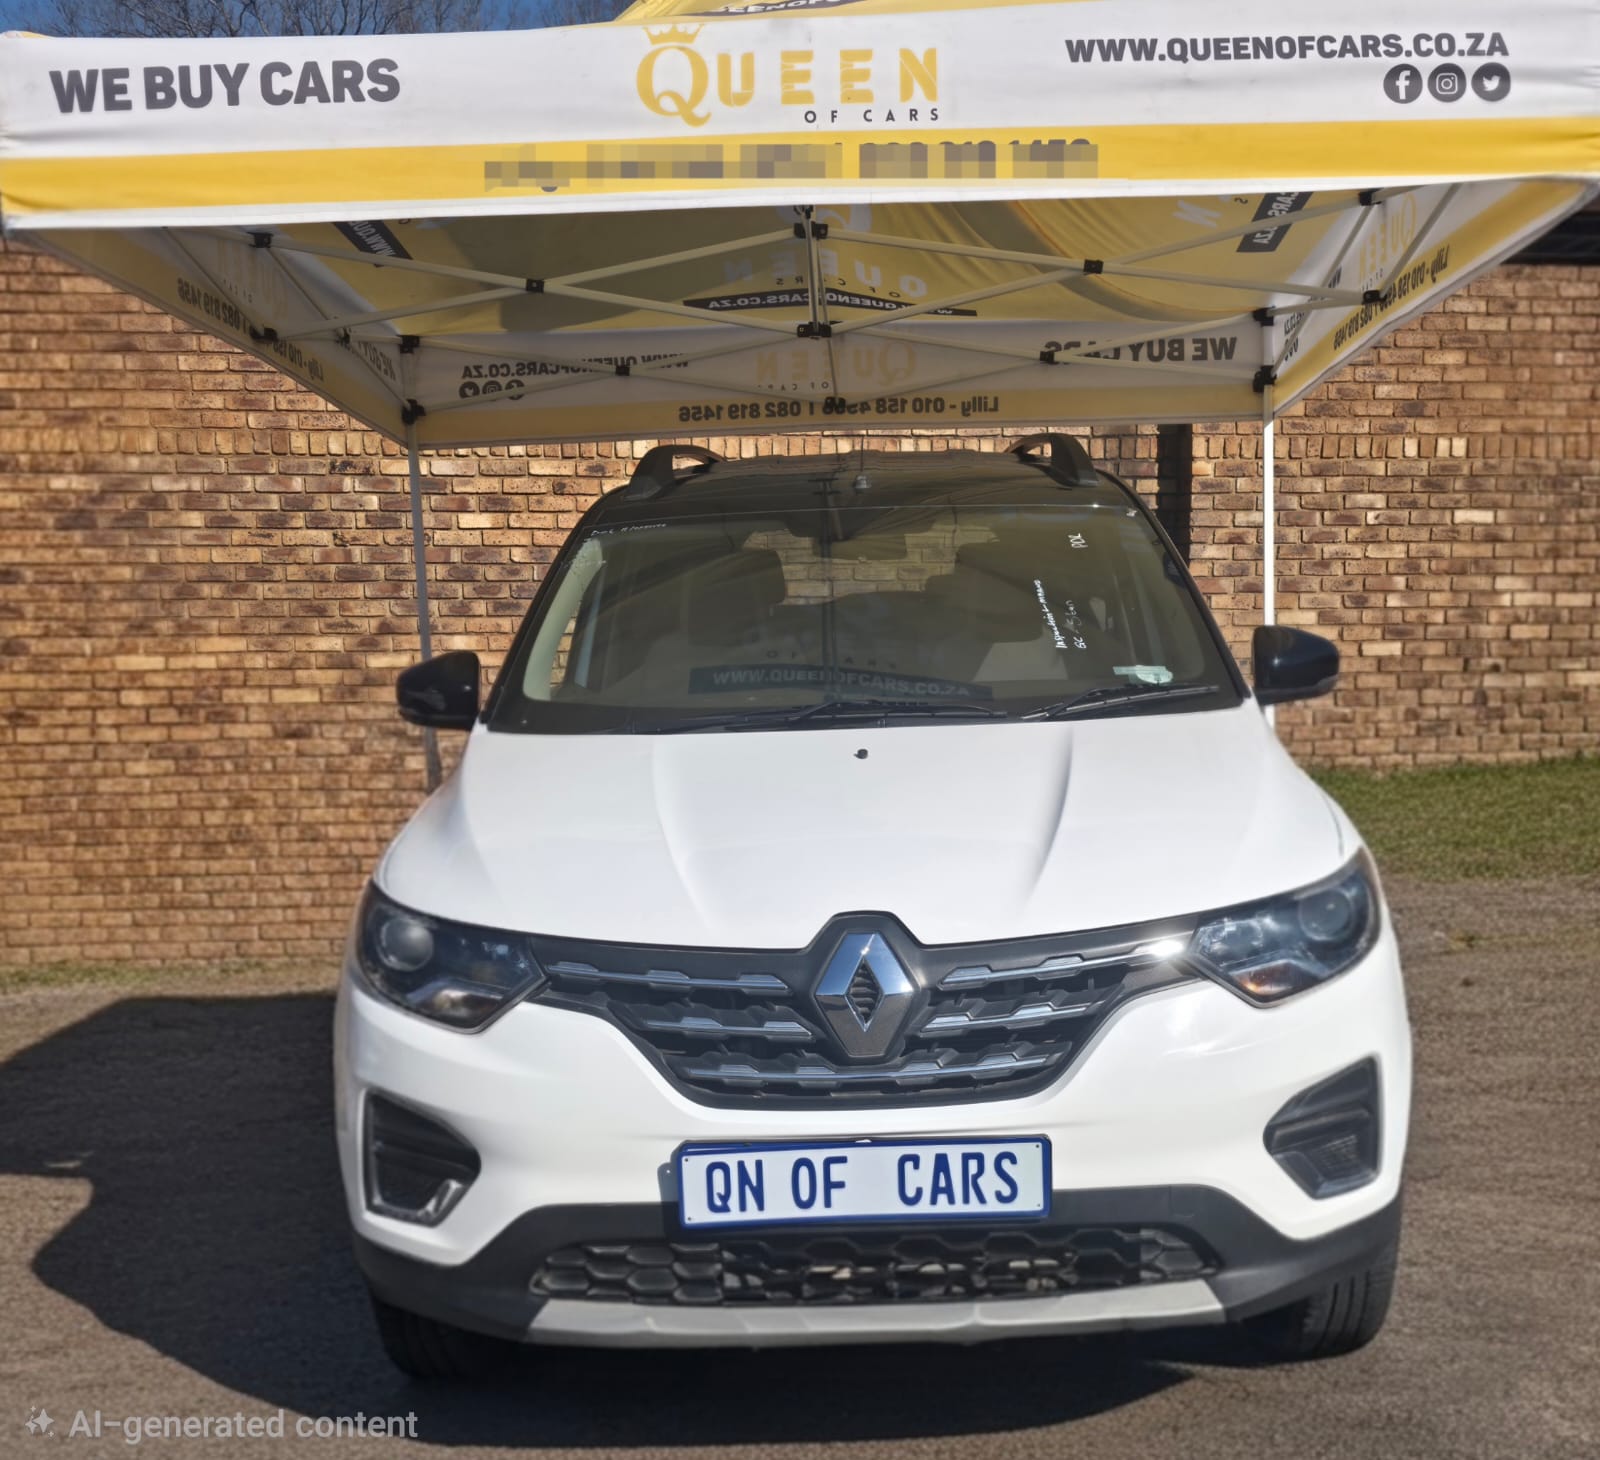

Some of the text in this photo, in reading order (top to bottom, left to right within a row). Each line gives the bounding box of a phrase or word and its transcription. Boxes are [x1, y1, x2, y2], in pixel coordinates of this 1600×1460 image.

[1065, 32, 1509, 63] WWW.QUEENOFCARS.CO.ZA
[49, 58, 401, 113] WE BUY CARS
[636, 46, 938, 128] QUEEN
[804, 108, 938, 123] OF CARS
[706, 1151, 1018, 1213] QN OF CARS
